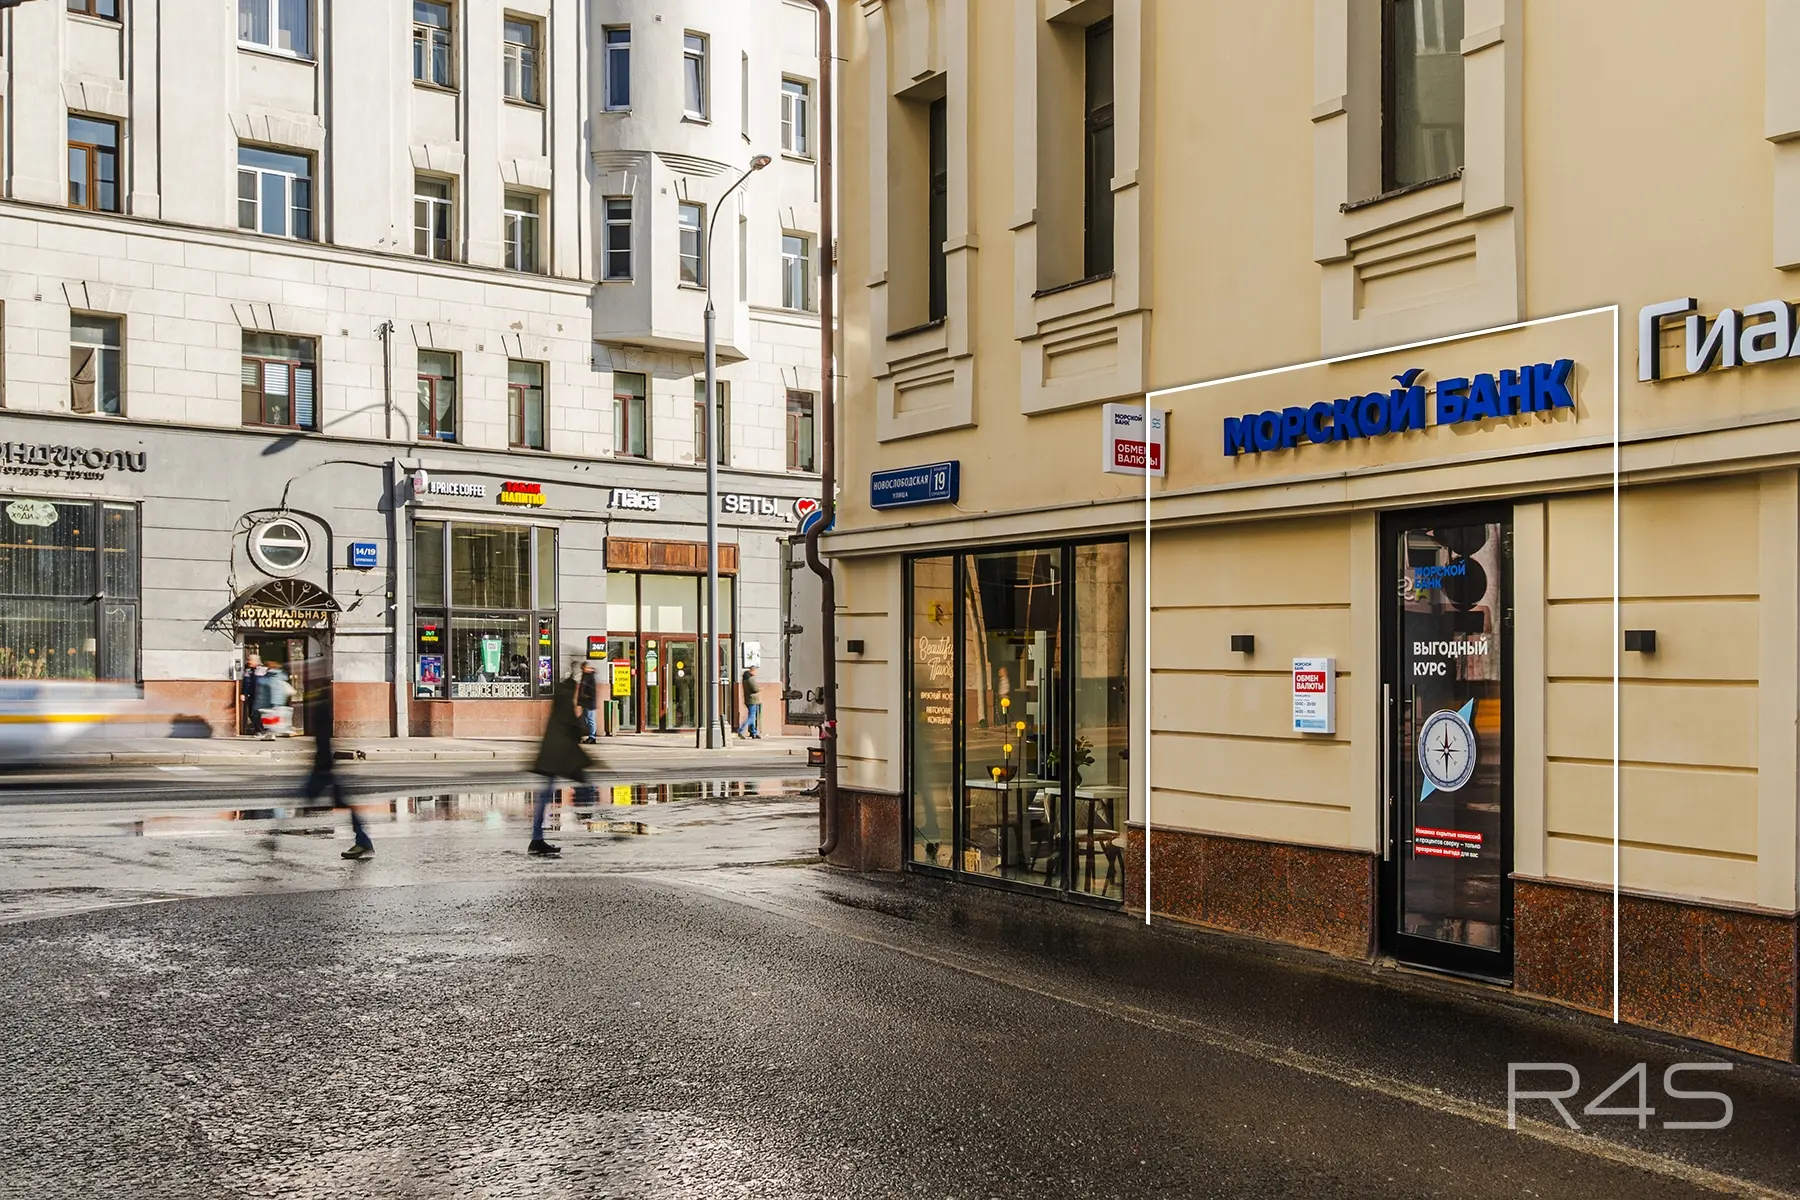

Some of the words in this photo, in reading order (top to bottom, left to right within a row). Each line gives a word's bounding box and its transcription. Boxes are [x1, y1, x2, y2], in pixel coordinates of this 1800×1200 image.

[1223, 368, 1425, 457] МОРСКОЙ
[1436, 358, 1575, 425] БАНК
[1115, 413, 1143, 422] МОРСКОЙ
[873, 474, 929, 491] НОВОСЛОБОДСКАЯ
[934, 471, 946, 491] 19
[436, 481, 459, 495] PRICE
[459, 483, 487, 497] COFFEE
[892, 491, 909, 499] УЛИЦА
[355, 547, 376, 556] 14/19
[1413, 560, 1466, 577] МОРСКОЙ
[1414, 578, 1442, 589] БАНК
[240, 609, 328, 619] НОТАРИАЛЬНАЯ
[258, 618, 309, 629] КОНТОРА
[1413, 636, 1488, 658] ВЫГОДНЫЙ
[1413, 662, 1447, 676] КУРС
[1296, 674, 1319, 682] ОБМЕН
[465, 684, 491, 697] PRICE
[492, 684, 525, 697] COFFEE
[1296, 682, 1324, 690] ВАЛЮТЫ
